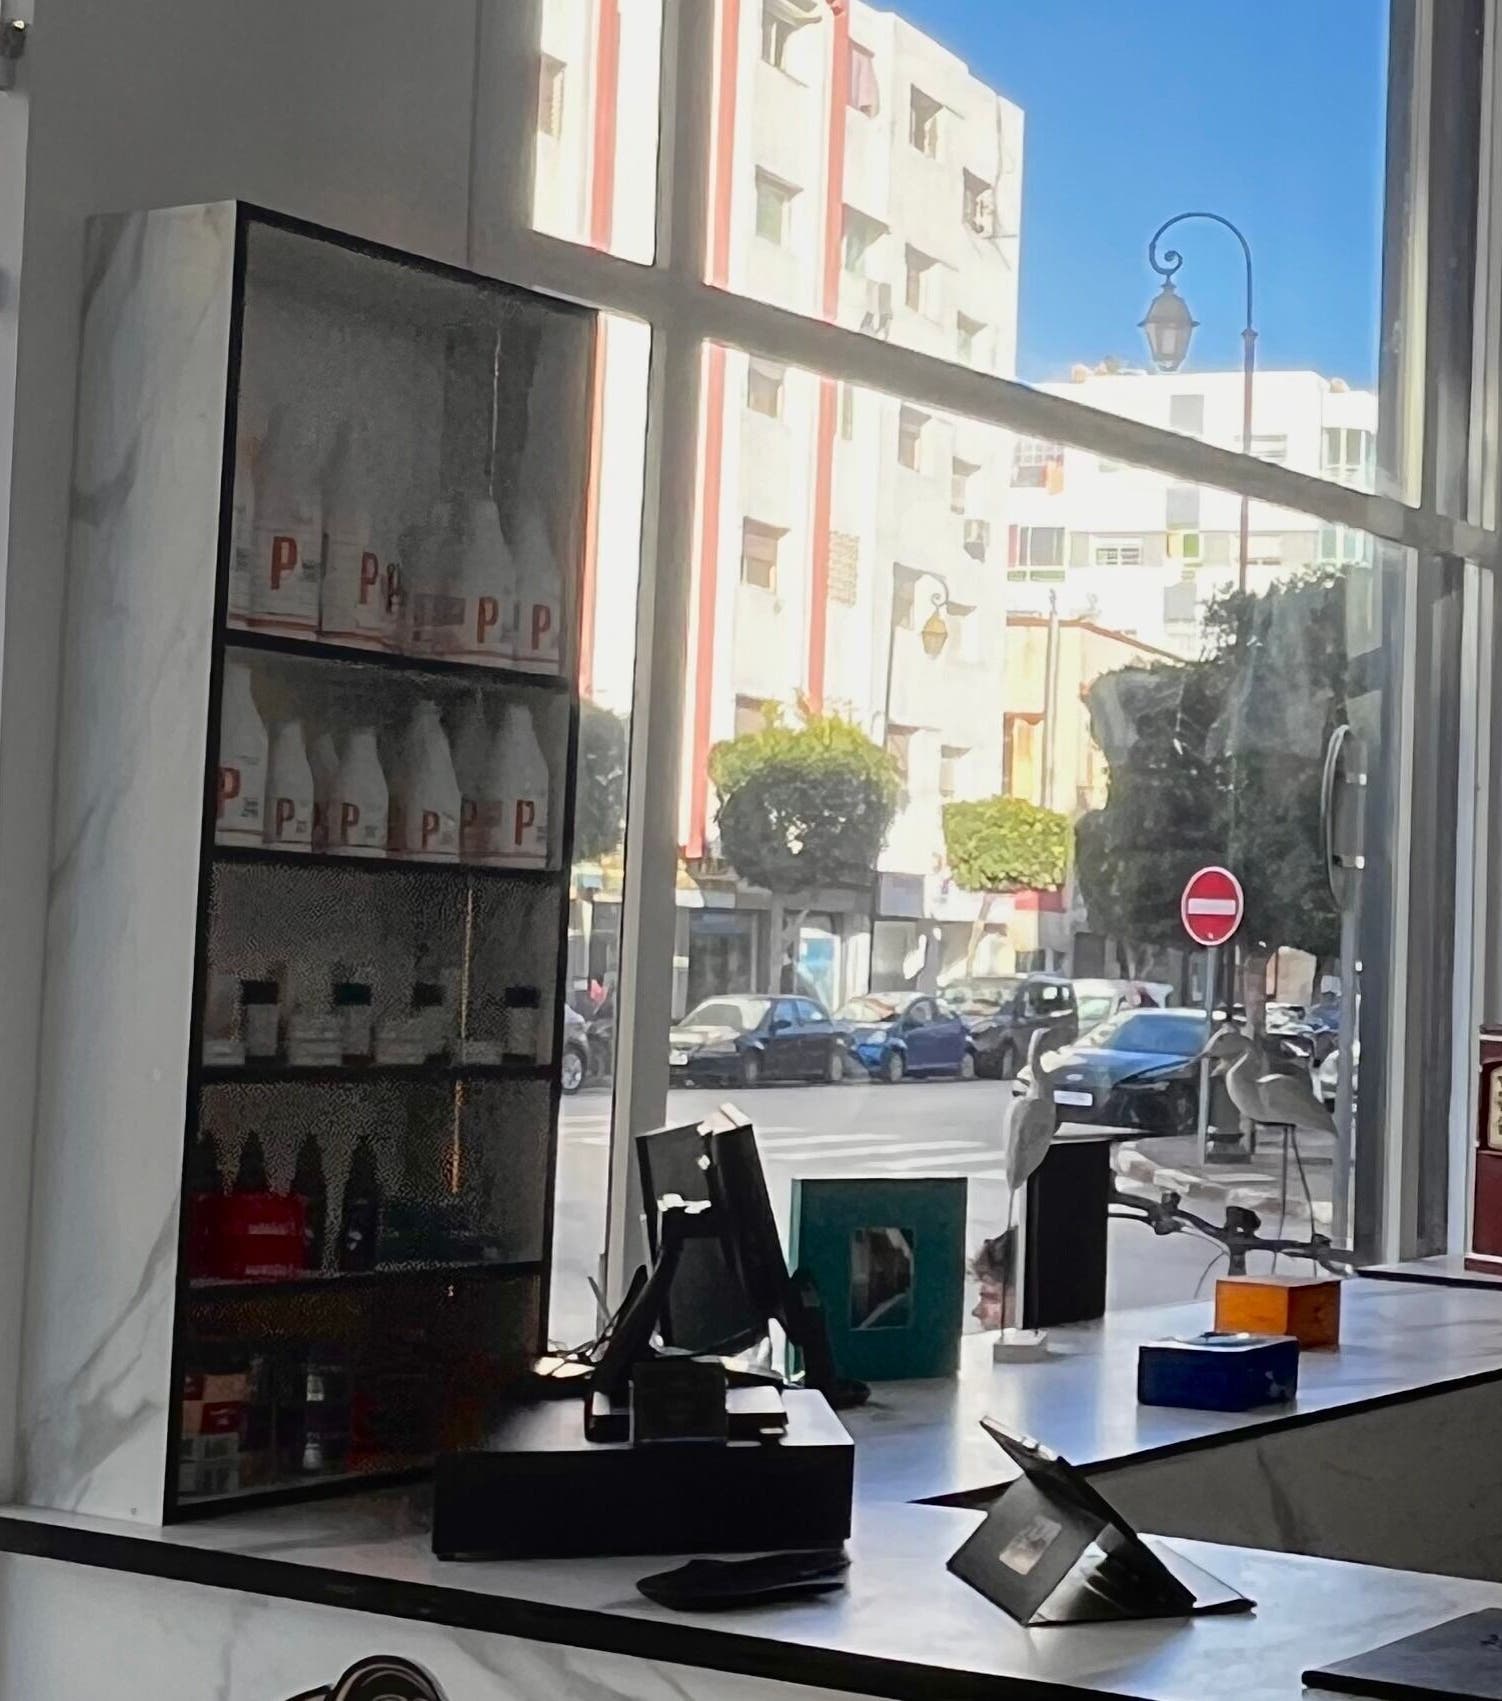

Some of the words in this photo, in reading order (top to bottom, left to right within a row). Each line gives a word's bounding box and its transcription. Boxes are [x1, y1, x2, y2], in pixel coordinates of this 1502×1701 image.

[270, 536, 298, 590] P
[359, 551, 379, 605] P
[477, 596, 498, 644] P
[530, 604, 551, 650] P
[514, 799, 535, 846] P
